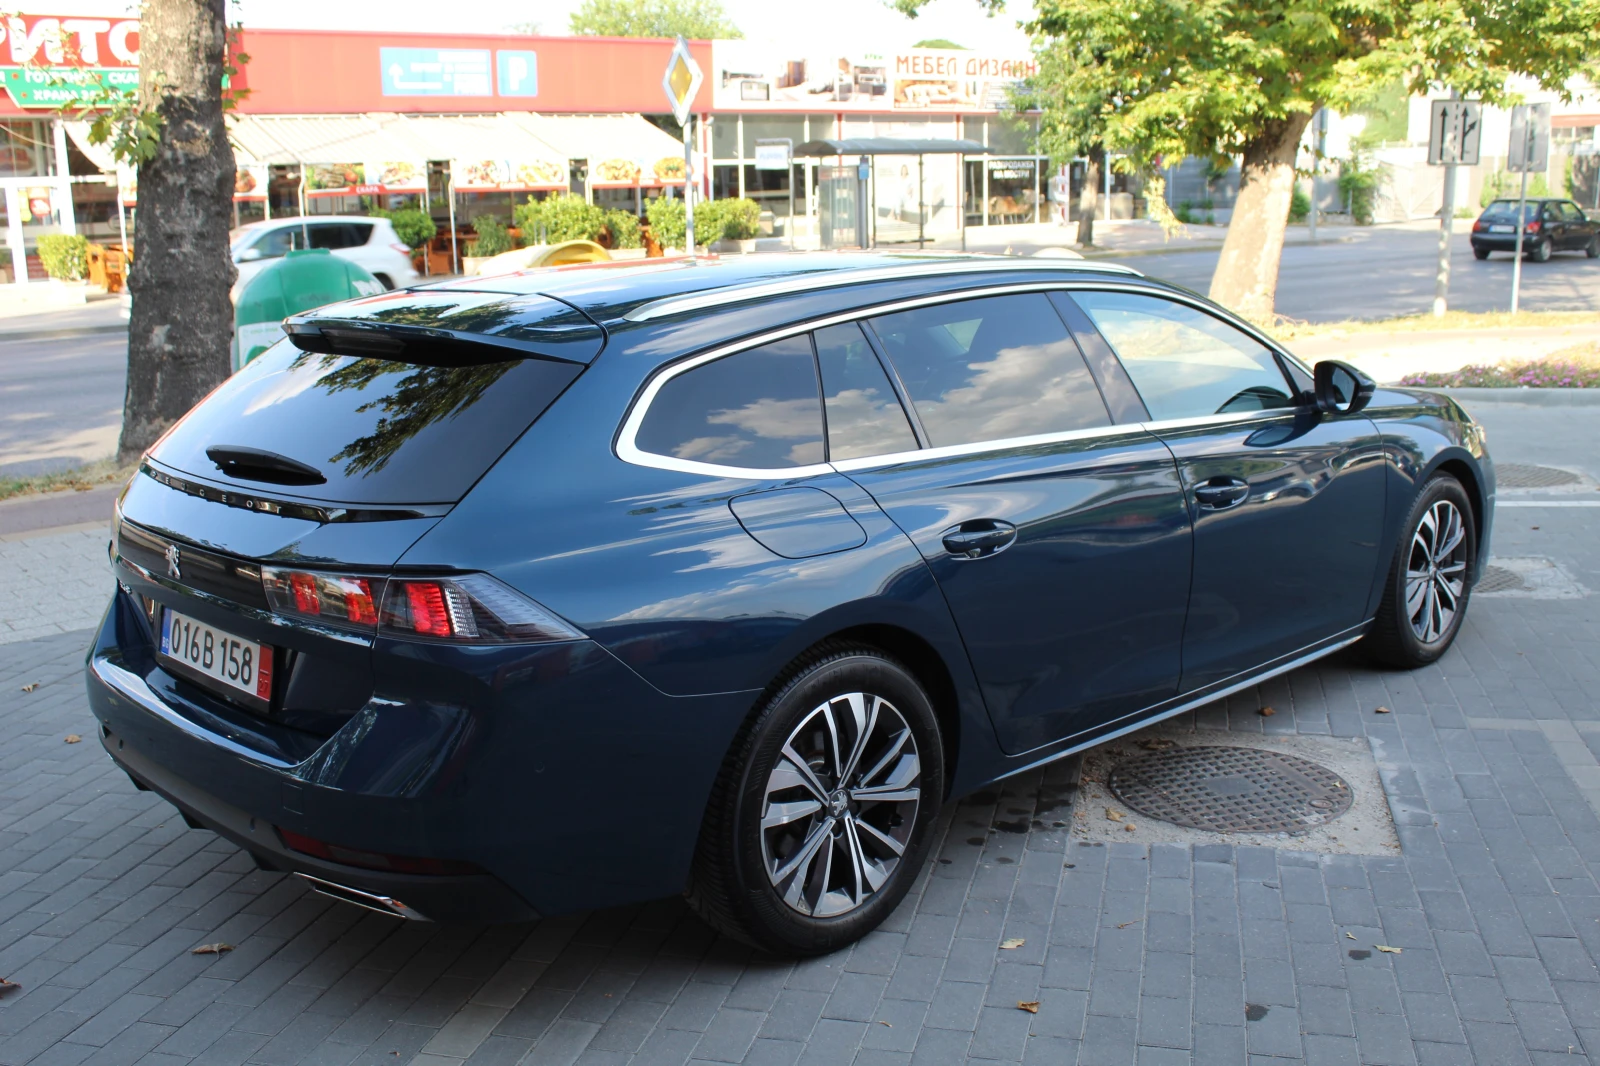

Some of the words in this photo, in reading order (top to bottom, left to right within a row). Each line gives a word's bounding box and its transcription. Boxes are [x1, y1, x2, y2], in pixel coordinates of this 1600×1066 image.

[508, 56, 527, 91] P
[896, 55, 957, 75] МЕБЕЛ
[150, 470, 281, 514] PEUGEOT
